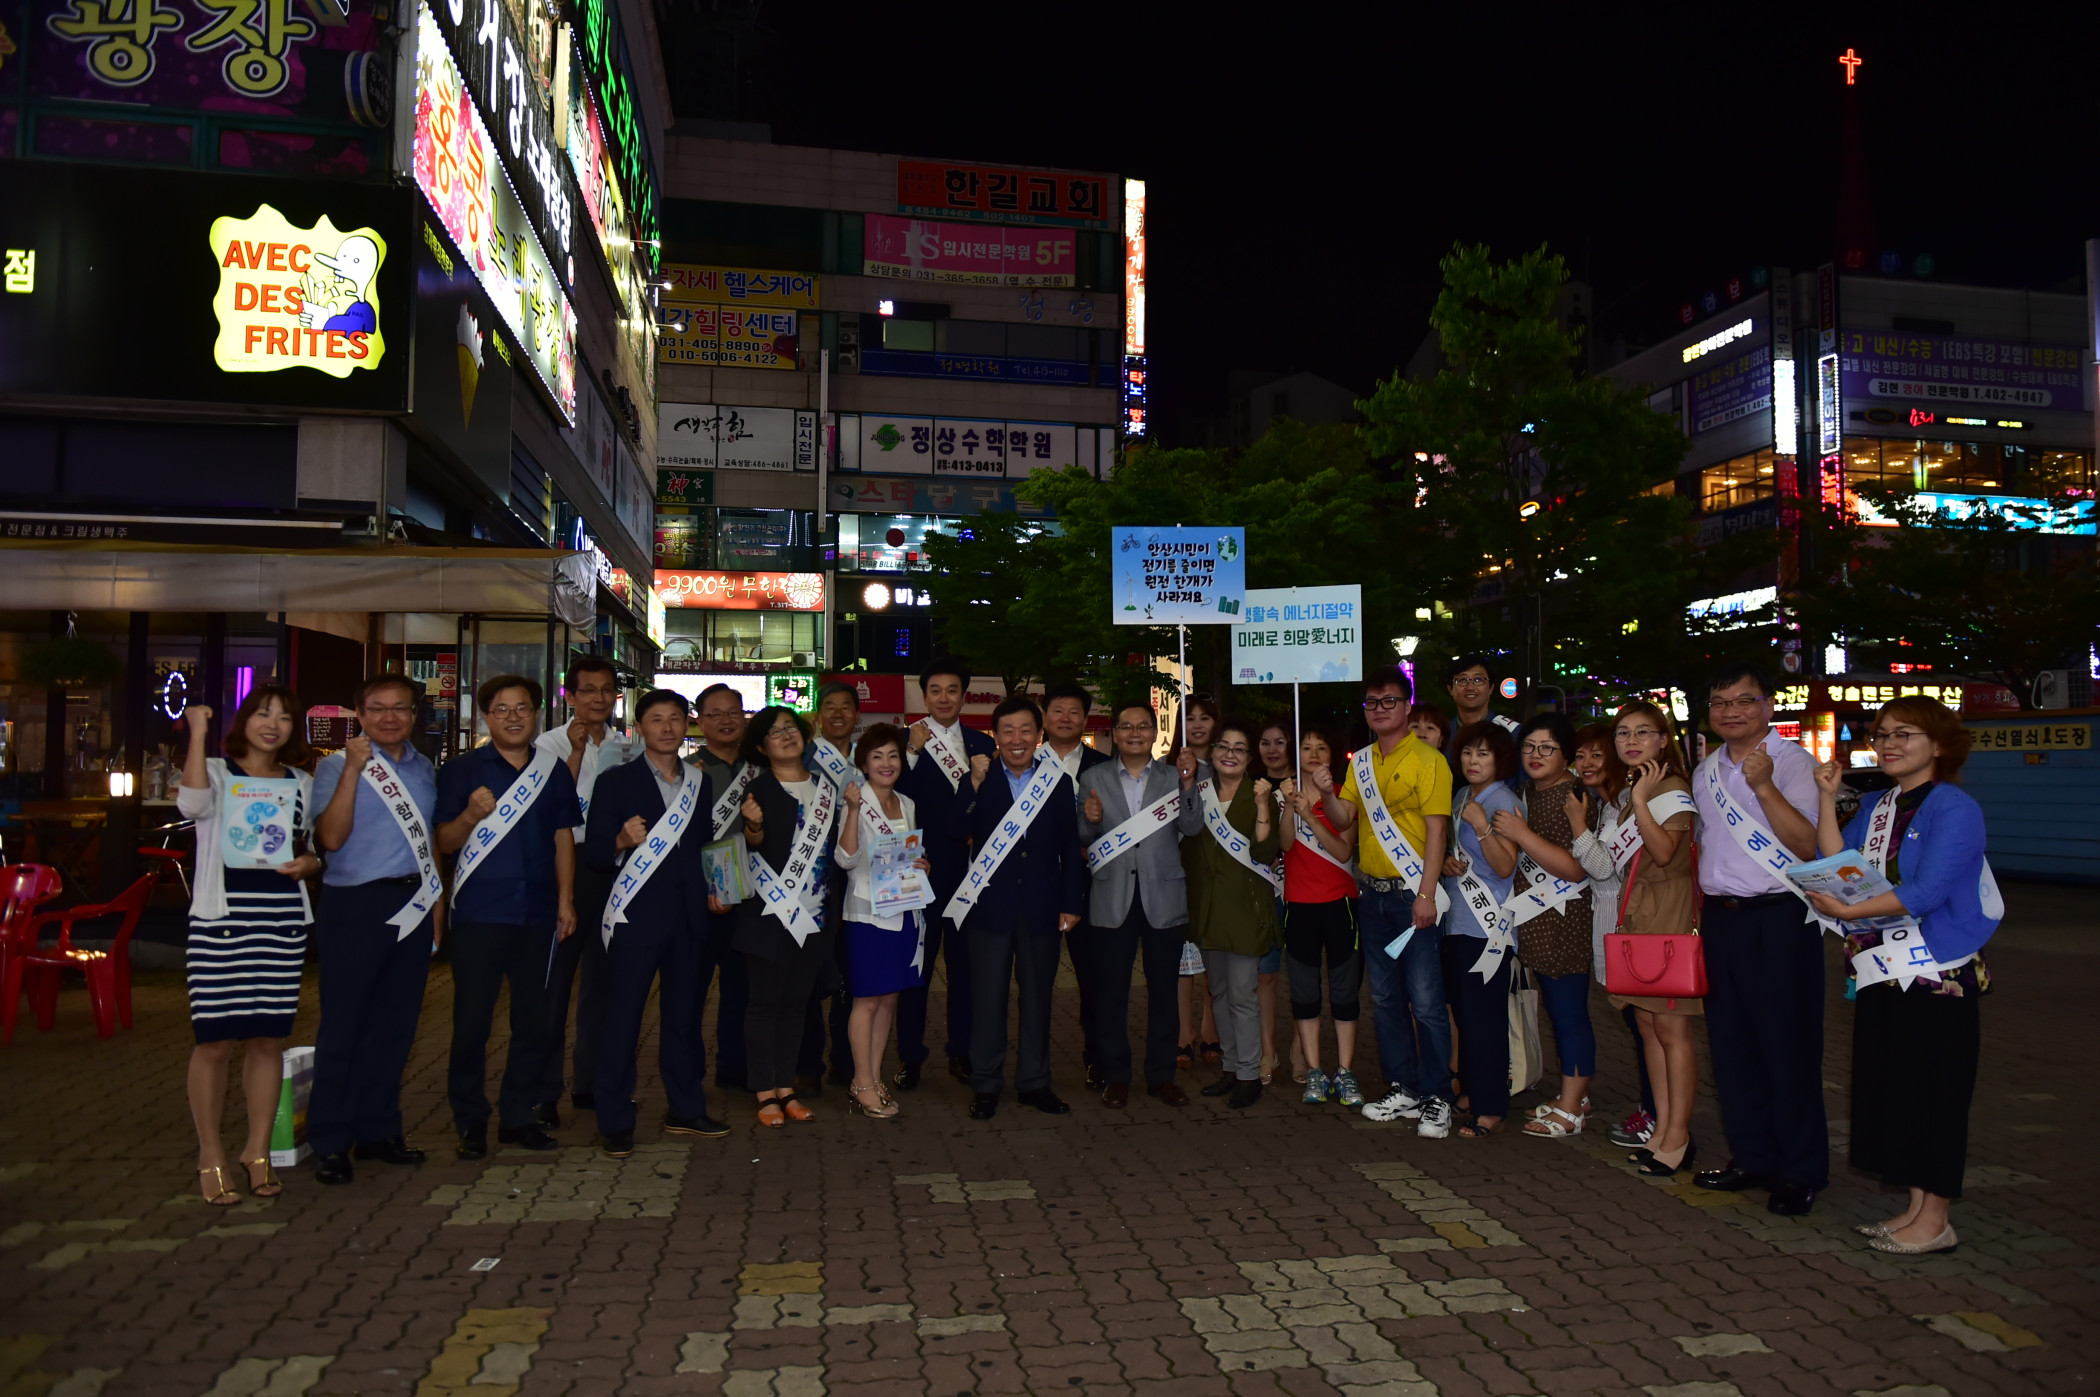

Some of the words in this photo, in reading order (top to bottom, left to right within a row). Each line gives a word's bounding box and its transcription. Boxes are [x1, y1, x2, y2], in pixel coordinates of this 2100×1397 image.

[944, 168, 1101, 218] 한길교회
[222, 239, 312, 272] AVEC
[942, 240, 1031, 261] 입시전문학원
[1035, 240, 1072, 266] 5F
[3, 248, 36, 294] 점
[723, 271, 814, 298] 헬스케어
[870, 263, 912, 280] 상담문의
[234, 282, 304, 315] DES
[1775, 283, 1790, 345] 스튜디오
[245, 324, 369, 360] FRITES
[659, 337, 760, 352] 031-405-8890
[668, 349, 778, 365] 010-5006-4122
[939, 358, 1001, 377] 정명학원
[2032, 347, 2079, 369] 전문강의
[1878, 381, 1899, 395] 김현
[1902, 382, 1924, 396] 영어
[1927, 384, 1970, 400] 전문학원
[798, 416, 812, 465] 입시전문
[911, 426, 1051, 459] 정상수학학원
[7, 522, 47, 538] 전문점
[62, 524, 129, 539] 크림생맥주
[1147, 542, 1211, 558] 안산시민이
[1142, 558, 1177, 574] 전기를
[1181, 558, 1216, 574] 줄이면
[668, 575, 736, 599] 9900원
[1144, 575, 1171, 590] 원전
[1173, 574, 1214, 590] 한개가
[1156, 591, 1204, 604] 사라져요
[1283, 602, 1354, 622] 에너지절약
[1238, 630, 1279, 648] 미래로
[1283, 626, 1355, 646] 희망愛너지
[2054, 727, 2087, 747] 도장
[498, 770, 545, 825] 시민이
[667, 779, 698, 831] 시민이
[1019, 772, 1054, 818] 시민이
[1708, 770, 1745, 827] 시민이
[1355, 753, 1379, 799] 시민이
[1372, 806, 1425, 878] 에너지다
[1207, 806, 1248, 853] 시민이
[969, 820, 1021, 889] 에너지다
[610, 836, 668, 914] 에너지다
